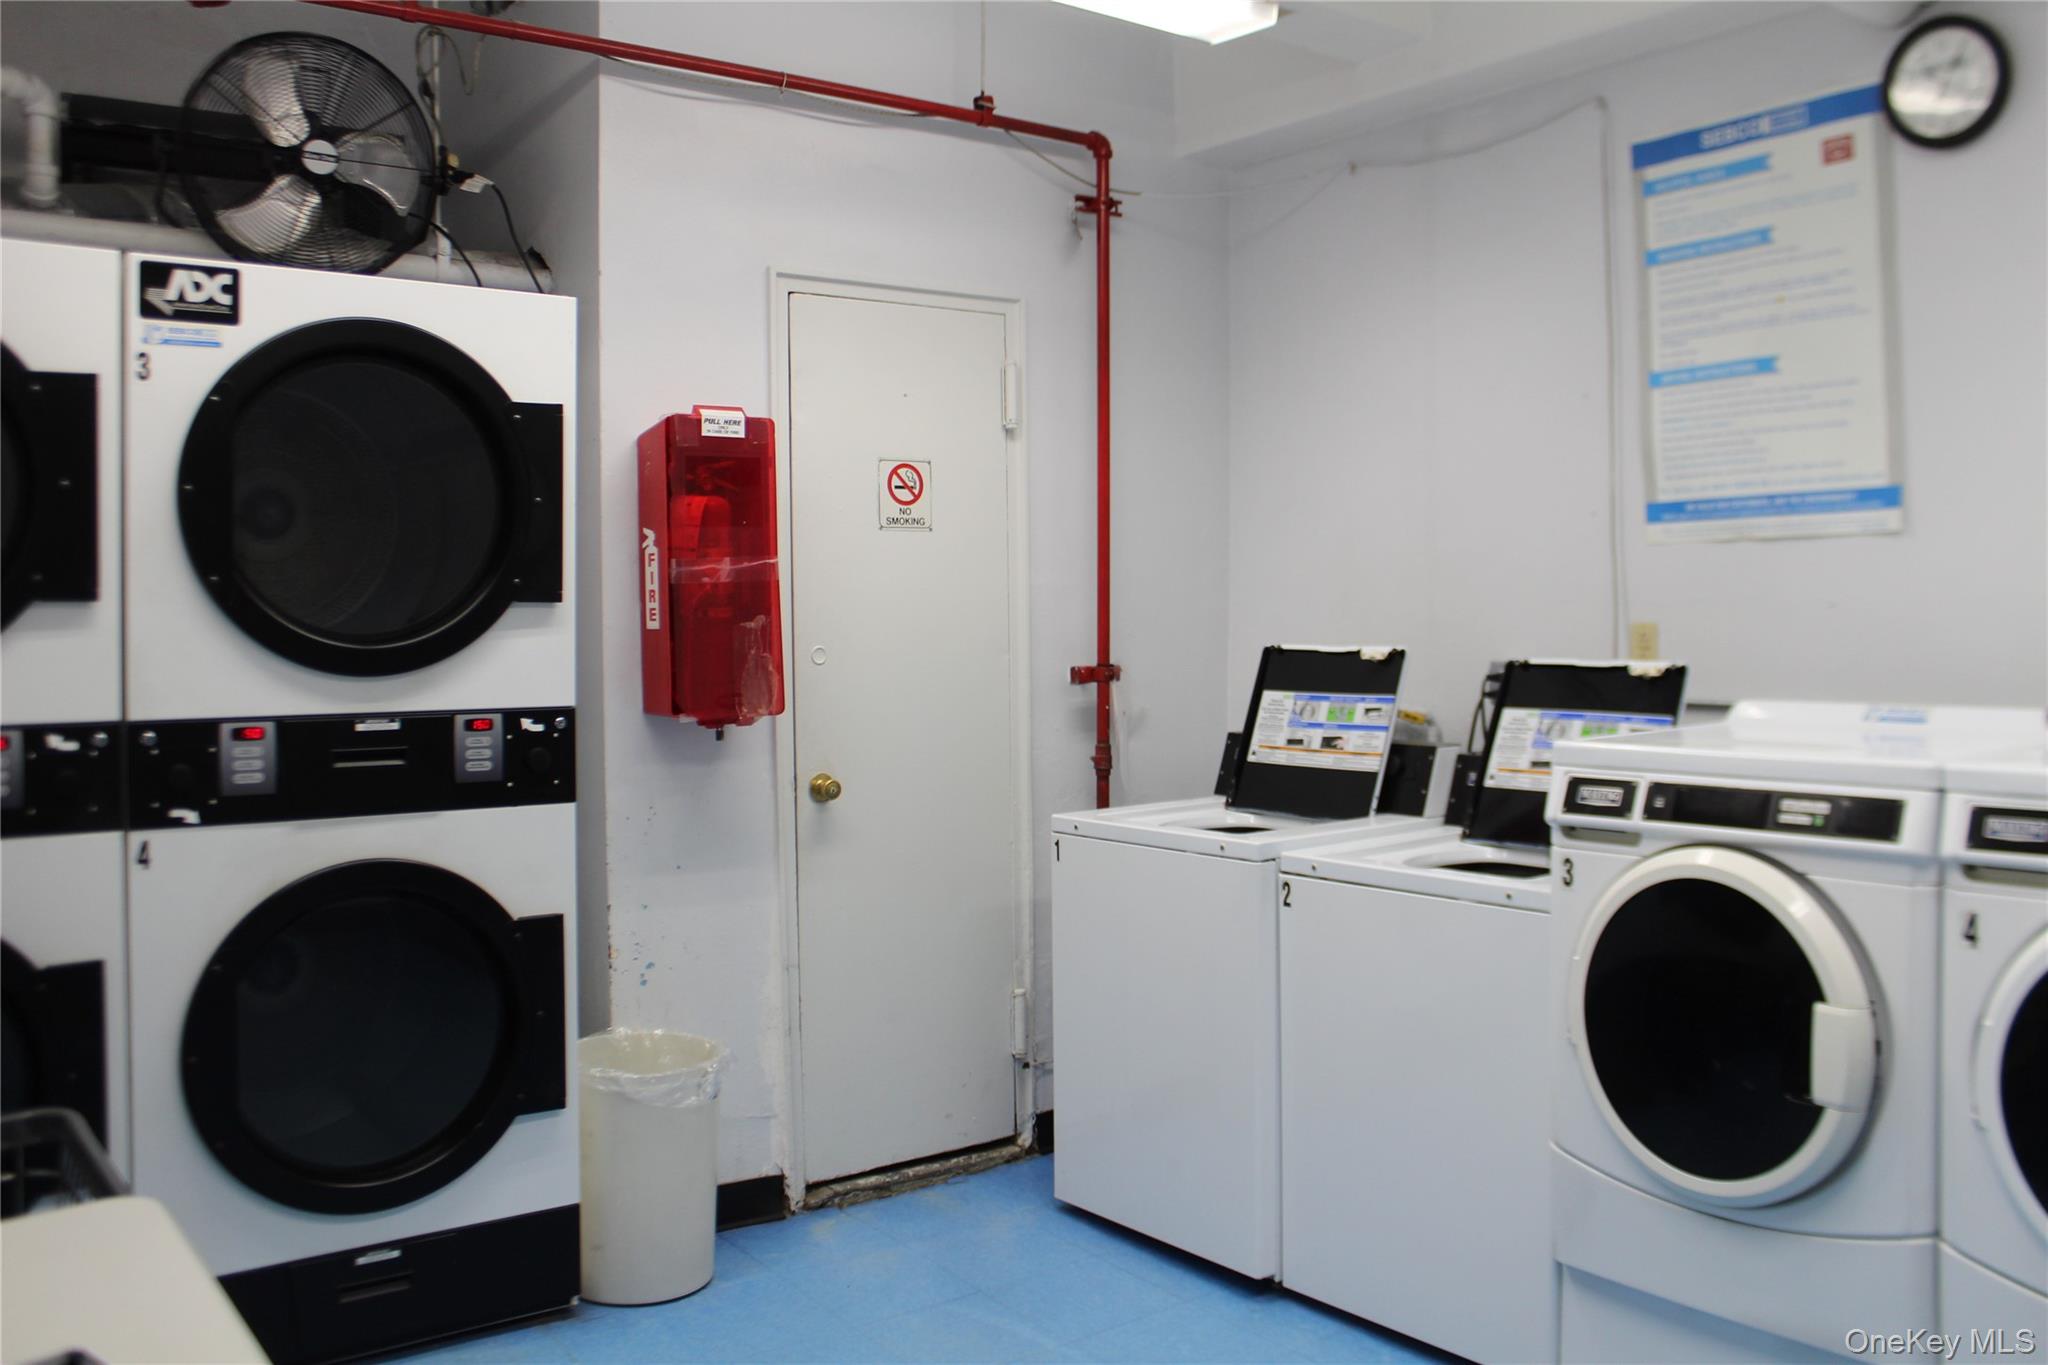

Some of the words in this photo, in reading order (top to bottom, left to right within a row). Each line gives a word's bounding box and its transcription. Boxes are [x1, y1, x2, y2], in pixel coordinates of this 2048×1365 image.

[165, 269, 233, 305] ADC
[137, 352, 150, 380] 3
[703, 417, 721, 425] PULL
[886, 516, 926, 526] SMOKING
[899, 507, 912, 516] NO
[647, 552, 657, 622] FIRE
[137, 840, 151, 869] 4
[1054, 839, 1061, 862] 1
[1562, 857, 1573, 887] 3
[1282, 880, 1292, 907] 2
[1963, 912, 1977, 945] 4
